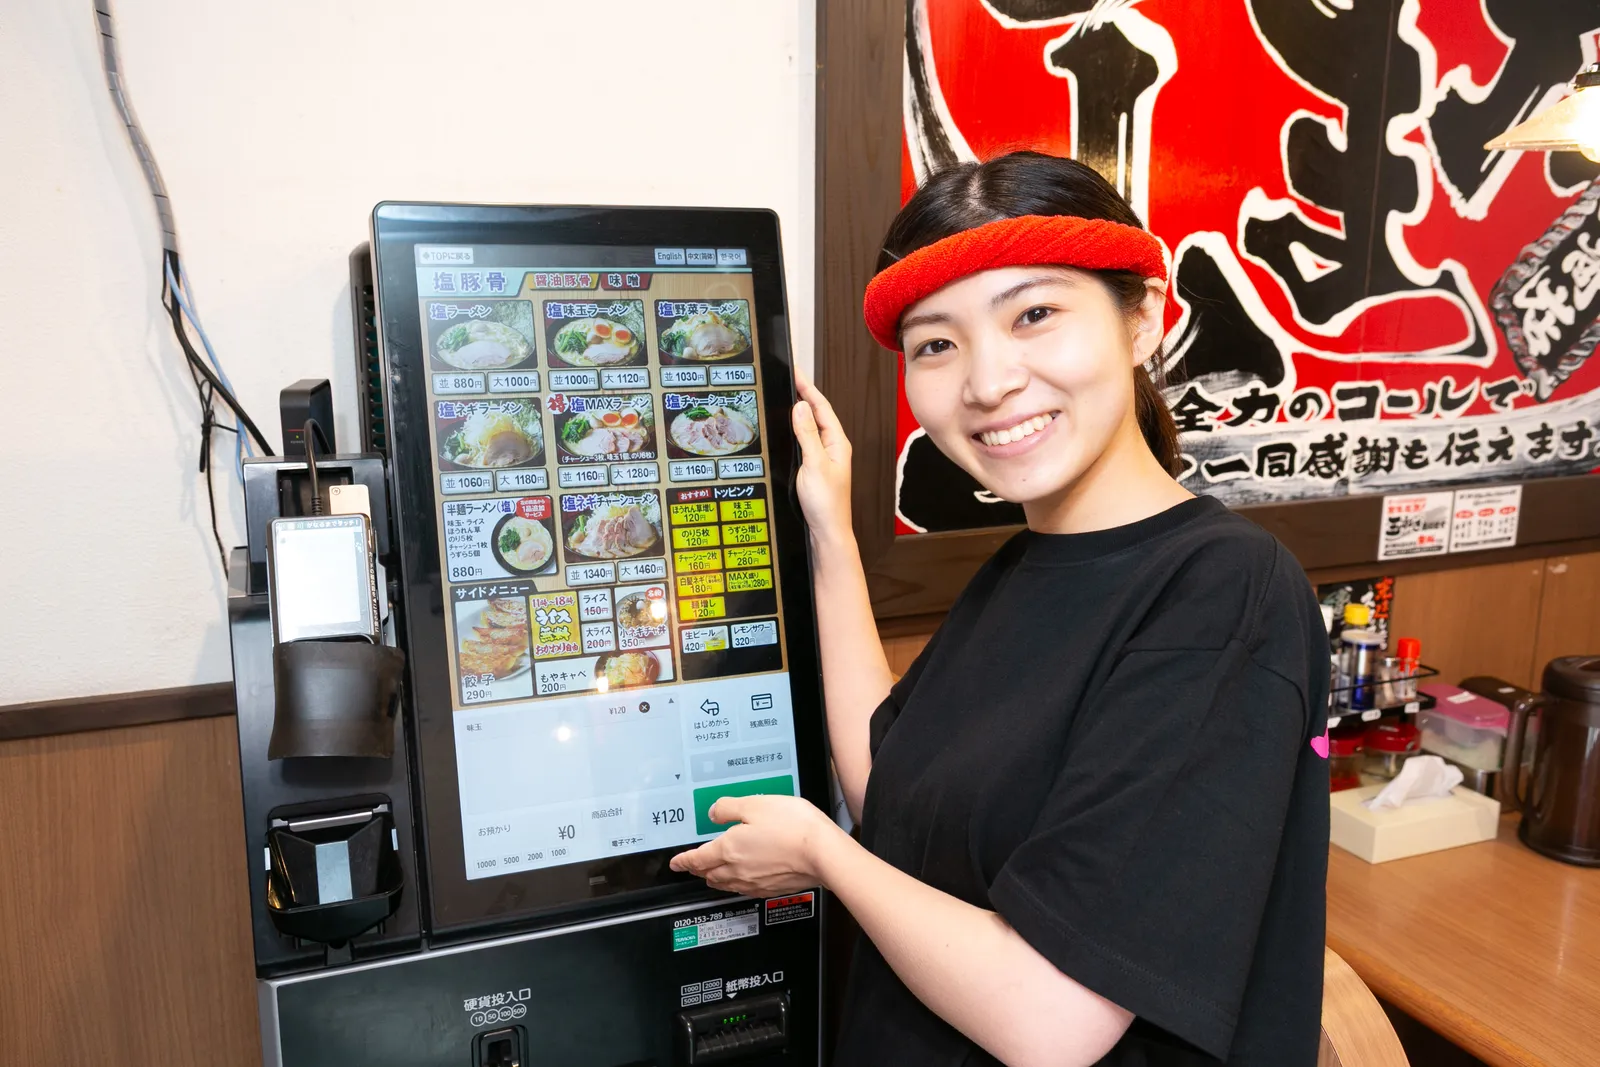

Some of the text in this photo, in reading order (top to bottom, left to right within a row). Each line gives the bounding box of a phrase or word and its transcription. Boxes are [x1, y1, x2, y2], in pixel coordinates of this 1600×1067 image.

[657, 252, 682, 261] English
[720, 252, 742, 261] 한국어
[433, 272, 506, 292] 塩豚骨
[535, 273, 591, 287] 醤油豚骨
[608, 273, 640, 287] 味噌
[430, 304, 492, 319] 塩ラーメン
[547, 303, 629, 318] 塩味玉ラーメン
[659, 302, 739, 317] 塩野菜ラーメン
[571, 397, 649, 413] 塩MAXラーメン
[666, 394, 753, 409] 塩チャーシューメン
[439, 403, 521, 418] 塩ネギラーメン
[714, 486, 754, 498] トッピング
[563, 493, 657, 511] 塩ネギチャーシューメン
[733, 502, 752, 510] 味玉
[672, 504, 714, 514] ほうれん草増し
[684, 513, 706, 523] 120円
[732, 510, 754, 519] 120円
[681, 529, 710, 538] のり5枚
[727, 525, 762, 534] うずら増し
[686, 537, 708, 547] 120円
[735, 533, 756, 543] 120円
[679, 553, 717, 562] チャーシュー2枚
[728, 549, 766, 558] チャーシュー4枚
[688, 561, 710, 571] 160円
[737, 557, 759, 566] 280円
[452, 566, 482, 578] 880円
[753, 578, 769, 588] 280円
[456, 586, 529, 598] サイドメニュー
[690, 585, 712, 594] 180円
[583, 594, 608, 604] ライス
[584, 606, 609, 616] 150円
[693, 608, 715, 618] 120円
[586, 626, 612, 637] 大ライス
[685, 629, 715, 640] 生ビール
[733, 625, 770, 634] レモンサワー
[586, 640, 611, 649] 200円
[621, 638, 645, 648] 350円
[685, 641, 705, 651] 420円
[735, 637, 755, 646] 320円
[463, 674, 495, 688] 餃子
[540, 670, 587, 683] もやキャベ
[541, 682, 566, 692] 200円
[466, 690, 492, 700] 290円
[609, 706, 626, 715] ¥120
[466, 723, 482, 732] 味玉
[694, 718, 730, 729] はじめから
[750, 718, 778, 728] 残高照会
[695, 731, 730, 741] やりなおす
[591, 806, 623, 820] 商品合計
[652, 808, 685, 825] ¥120
[478, 824, 511, 836] お預かり
[558, 824, 576, 840] ¥0
[611, 837, 643, 848] 電子マネー
[476, 848, 567, 869] 10000 5000 2000 1000
[674, 912, 723, 928] 0120-153-789
[684, 981, 720, 993] 1000 2000
[725, 971, 783, 993] 紙幣投入口
[463, 988, 532, 1011] 硬貨投入口
[683, 992, 721, 1005] 5000 10000
[513, 1007, 524, 1015] 500
